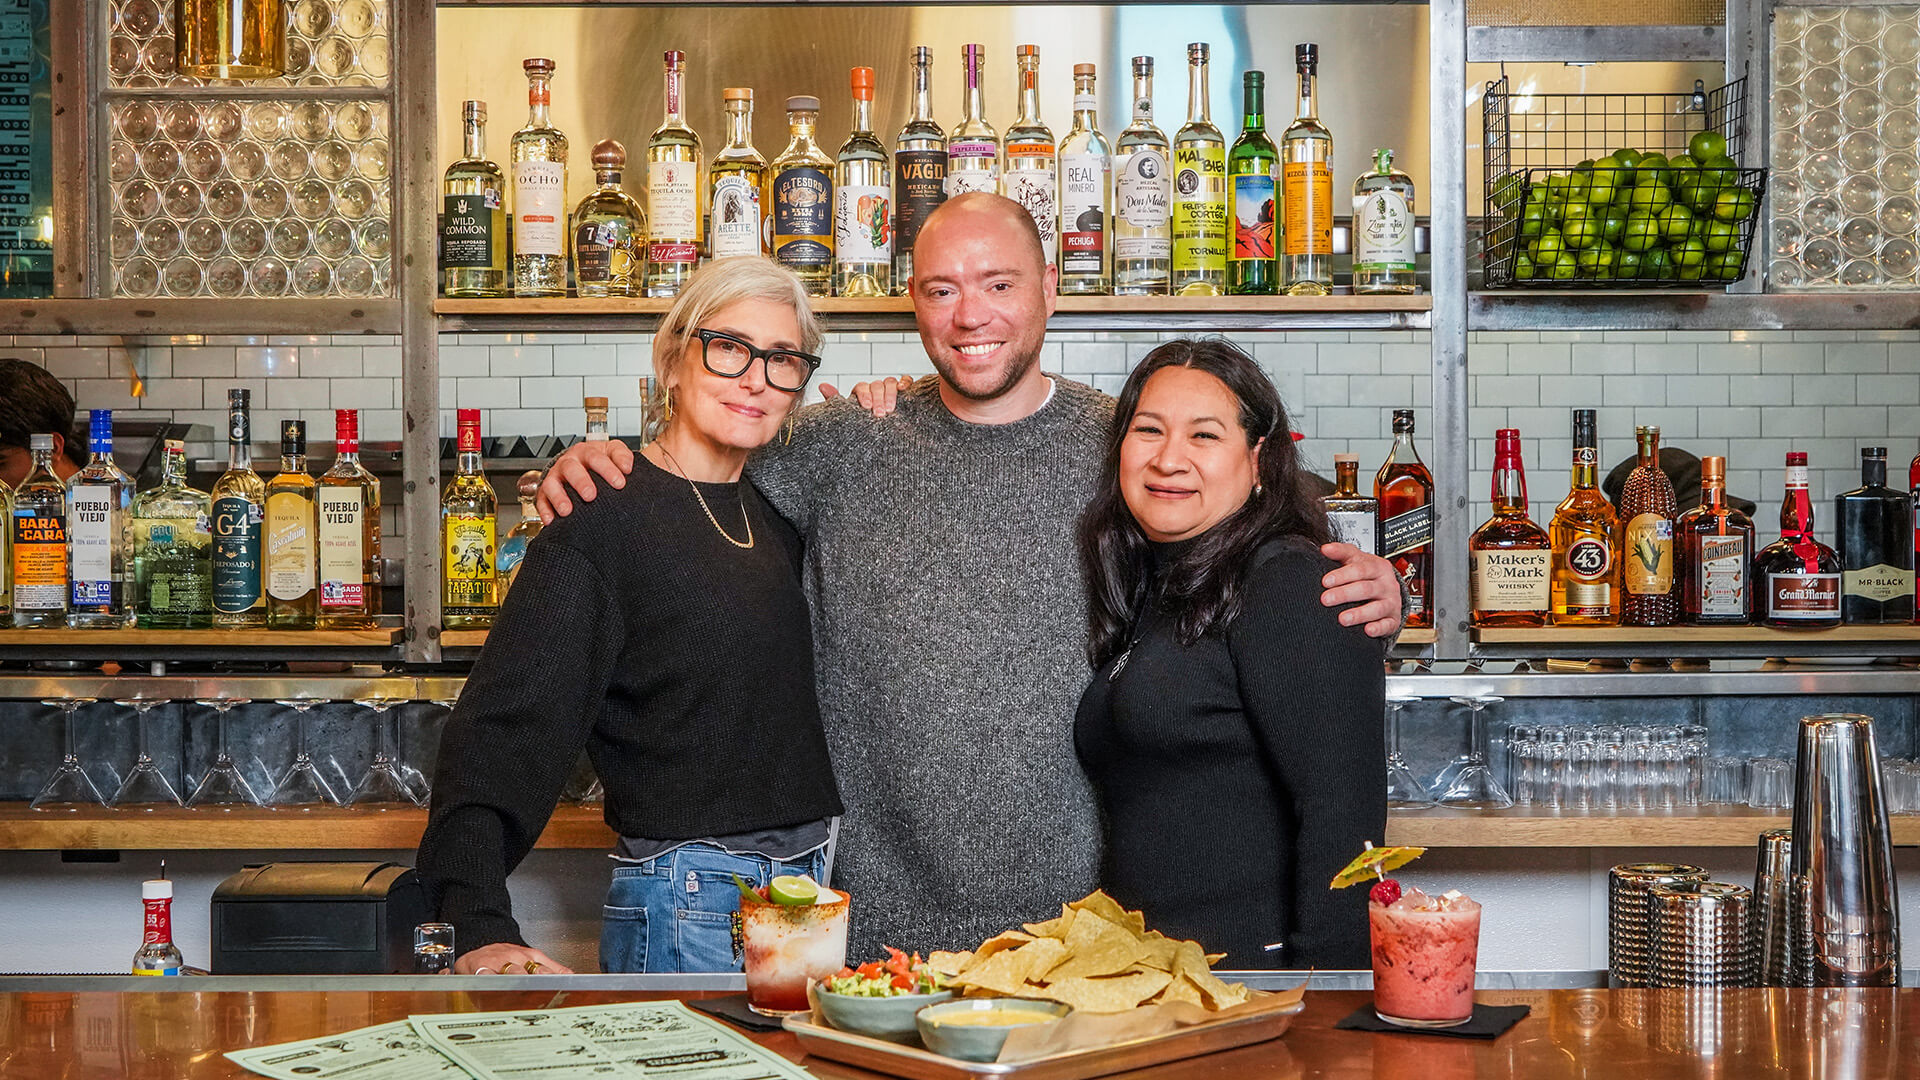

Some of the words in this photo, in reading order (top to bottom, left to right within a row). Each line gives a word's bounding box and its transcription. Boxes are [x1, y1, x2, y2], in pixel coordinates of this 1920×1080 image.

[1178, 150, 1204, 164] MAL
[1203, 159, 1225, 172] BIEN
[902, 164, 944, 180] VAGO
[1068, 168, 1095, 182] REAL
[519, 175, 559, 184] OCHO
[718, 178, 746, 187] TEQUILA
[782, 181, 791, 192] EL
[791, 177, 823, 192] TESORO
[1068, 183, 1095, 192] MINERO
[1126, 195, 1144, 208] Don
[1145, 194, 1168, 208] Mateo
[1190, 210, 1224, 218] CORTES
[452, 216, 476, 226] WILD
[446, 225, 487, 235] COMMON
[586, 227, 594, 240] 7
[718, 224, 752, 232] ARETTE
[1068, 237, 1096, 246] PECHUGA
[1580, 451, 1594, 460] 43
[75, 502, 110, 512] PUEBLO
[322, 502, 359, 512] PUEBLO
[79, 512, 105, 522] VIEJO
[326, 514, 354, 524] VIEJO
[20, 518, 60, 529] BARA
[217, 513, 251, 536] G4
[1384, 526, 1408, 539] BLACK
[1408, 519, 1431, 530] LABEL
[454, 524, 487, 538] Tequila
[1703, 542, 1742, 561] COINTREAU
[1486, 554, 1546, 565] Maker's
[1574, 548, 1601, 568] 43
[1503, 567, 1544, 578] Mark
[448, 581, 492, 594] TAPATIO
[1779, 588, 1804, 600] Grand
[1804, 588, 1836, 600] Marnier
[147, 914, 157, 924] 55
